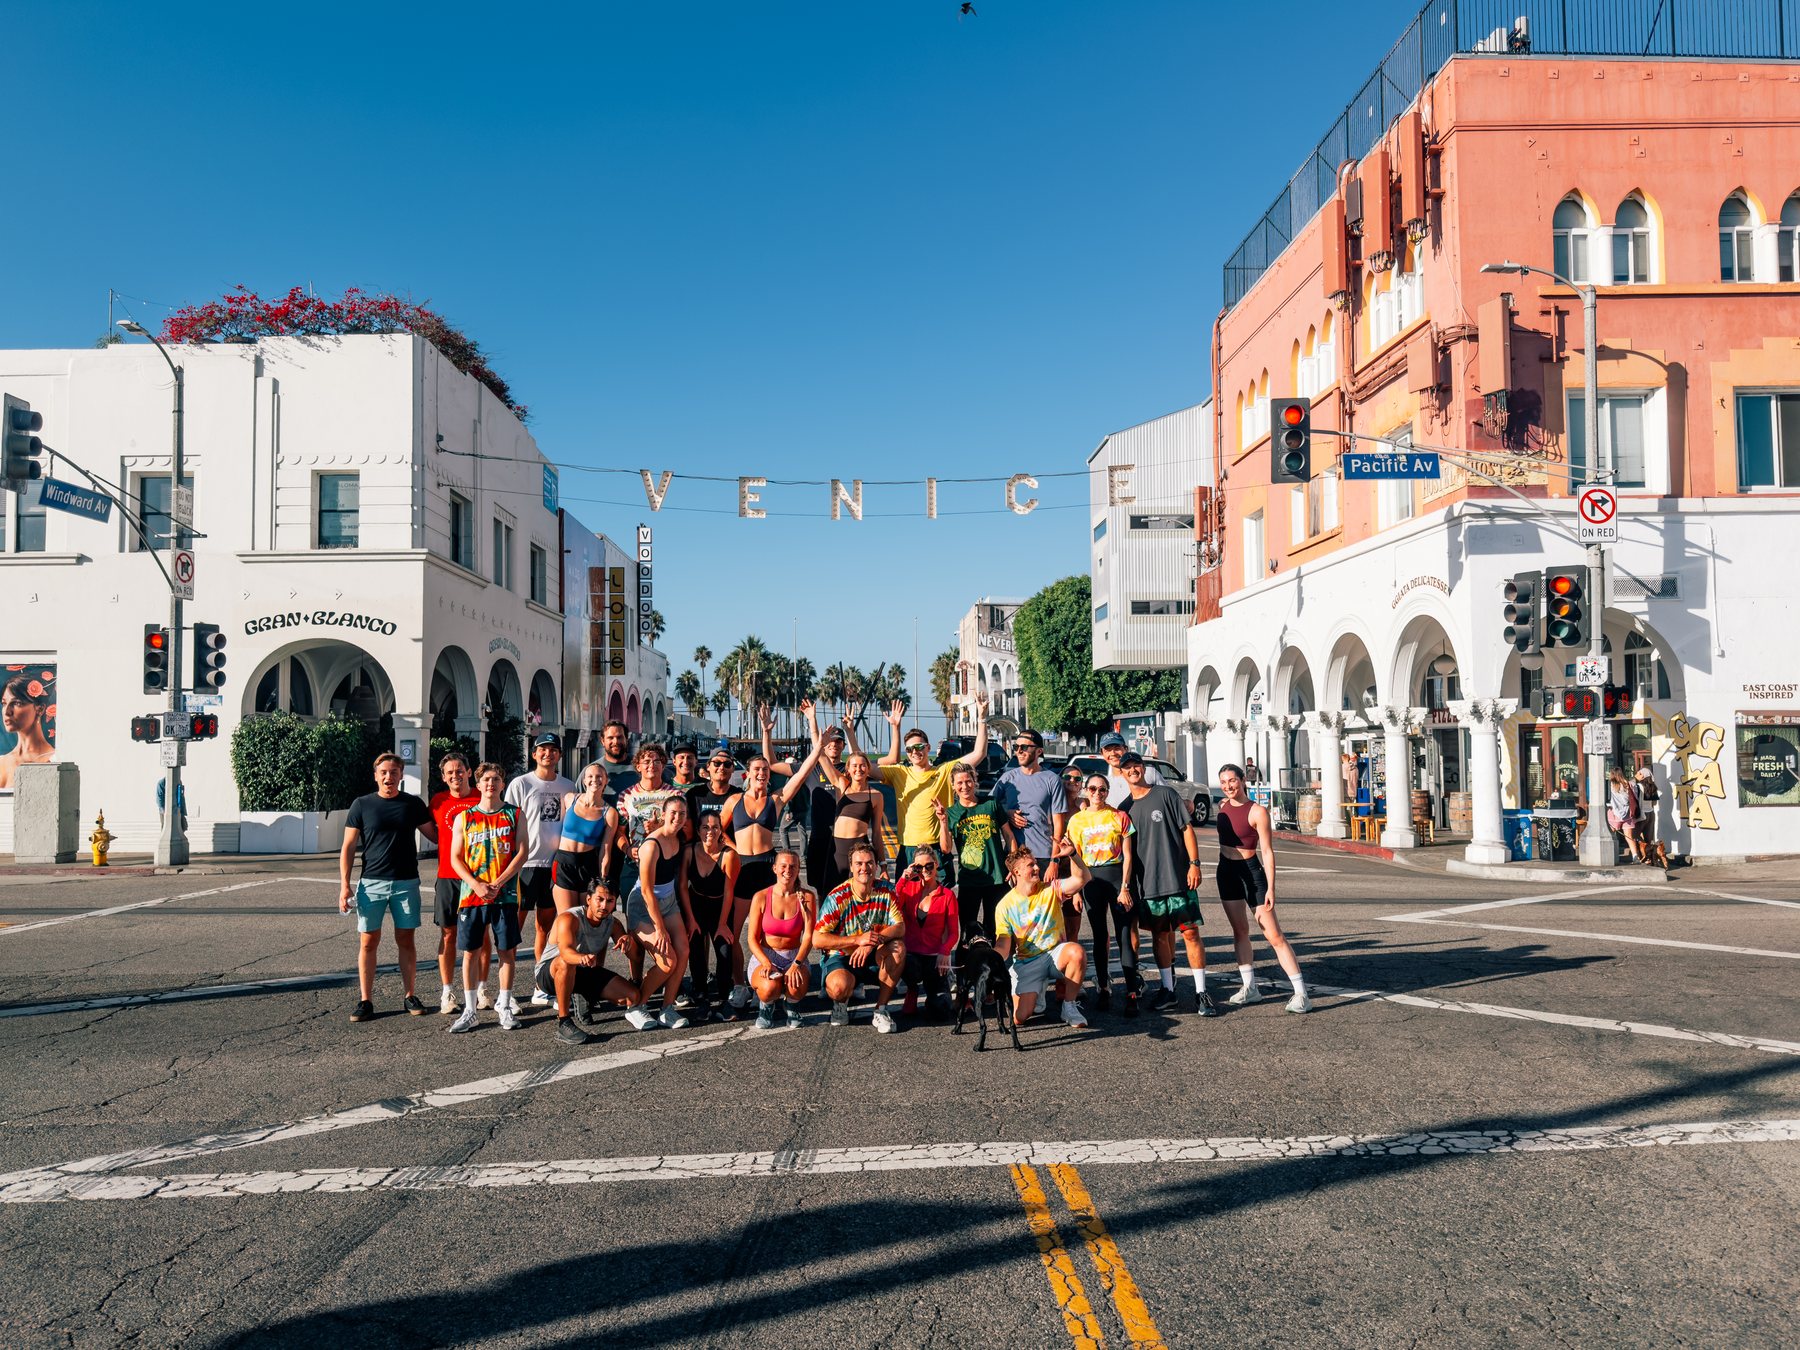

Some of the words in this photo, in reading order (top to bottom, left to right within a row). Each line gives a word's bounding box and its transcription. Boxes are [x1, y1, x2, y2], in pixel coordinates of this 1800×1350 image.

[1351, 458, 1408, 473] Pacific
[1413, 459, 1433, 472] Av
[46, 484, 93, 511] Windward
[94, 498, 108, 514] Av
[640, 464, 1136, 520] VENICE
[1581, 528, 1594, 538] ON
[1596, 528, 1615, 538] RED
[641, 530, 650, 631] VOODOO
[1410, 575, 1453, 597] DELICATESSEN
[244, 612, 302, 635] GRAN
[311, 610, 398, 636] BLANCO
[1743, 684, 1766, 692] EAST
[1768, 684, 1799, 692] COAST
[1749, 691, 1794, 699] INSPIRED
[165, 724, 175, 735] OK
[1752, 762, 1784, 771] FRESH
[956, 813, 991, 828] LITHUANIA
